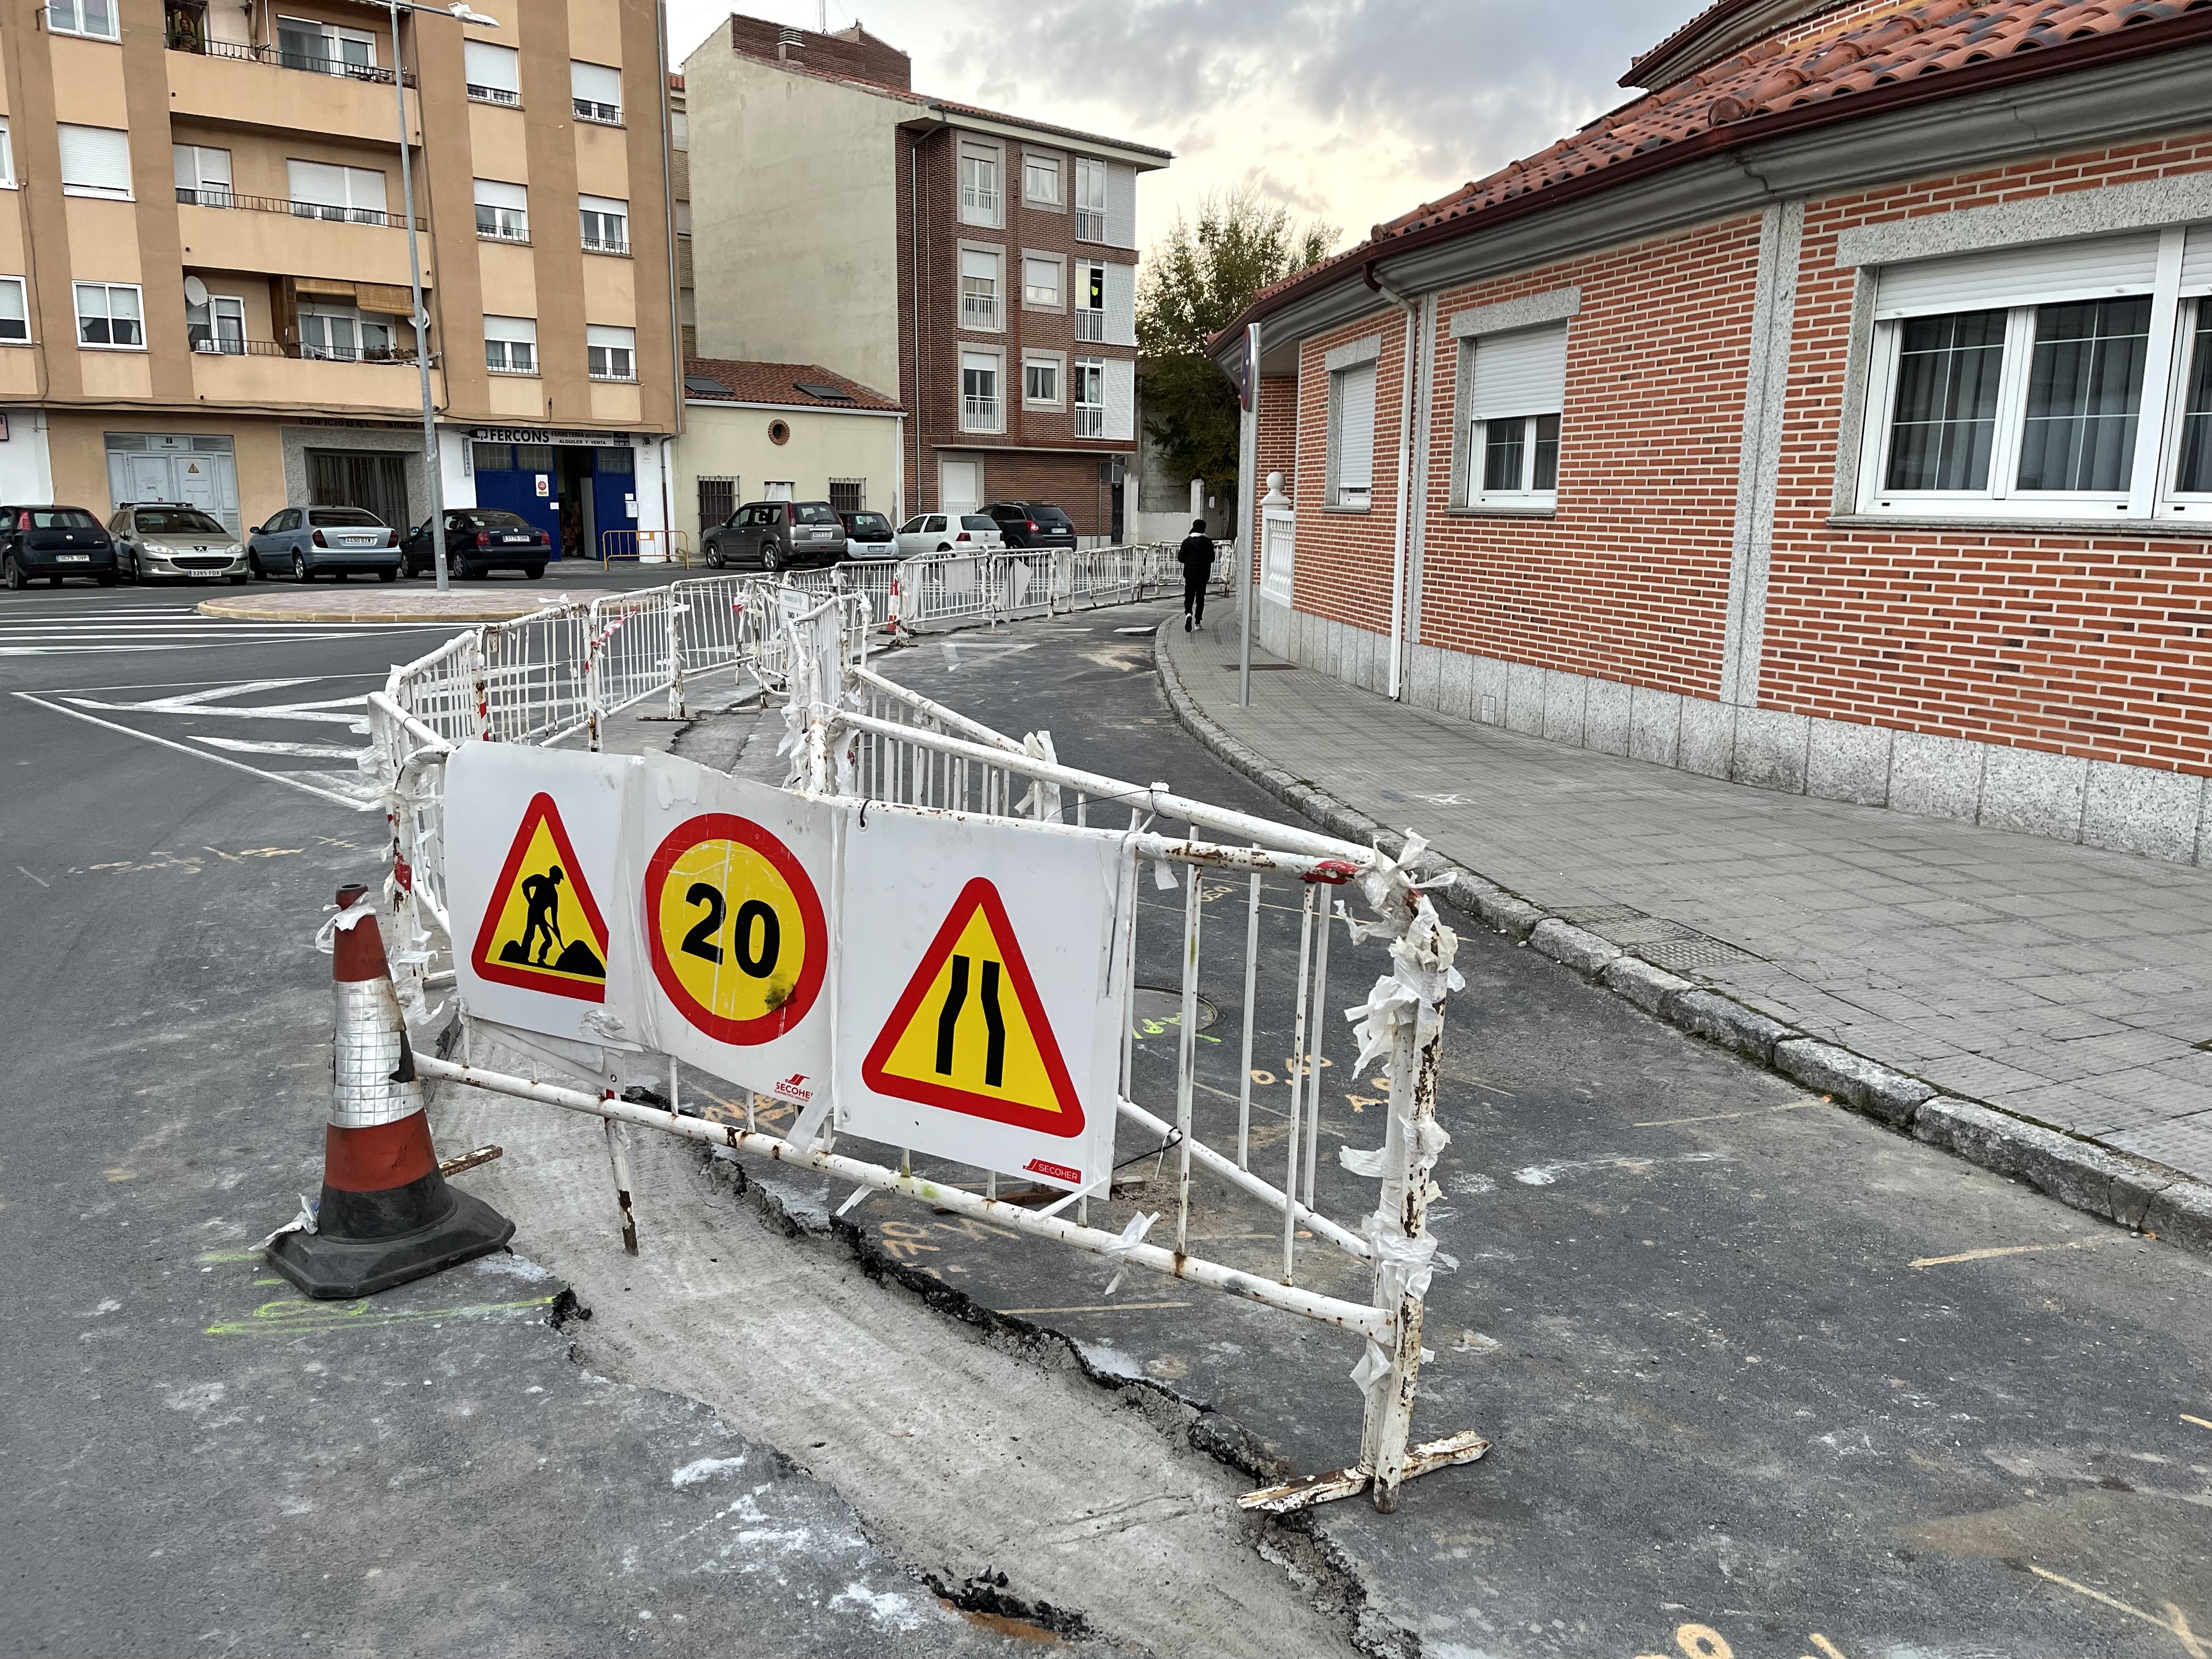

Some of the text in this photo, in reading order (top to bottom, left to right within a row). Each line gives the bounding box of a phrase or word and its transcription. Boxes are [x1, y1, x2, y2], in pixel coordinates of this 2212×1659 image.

[300, 417, 344, 426] EDIFICIO
[490, 428, 549, 443] FERCONS
[681, 882, 780, 979] 20
[776, 1081, 814, 1099] SECOHE
[1039, 1164, 1078, 1181] SECOHER
